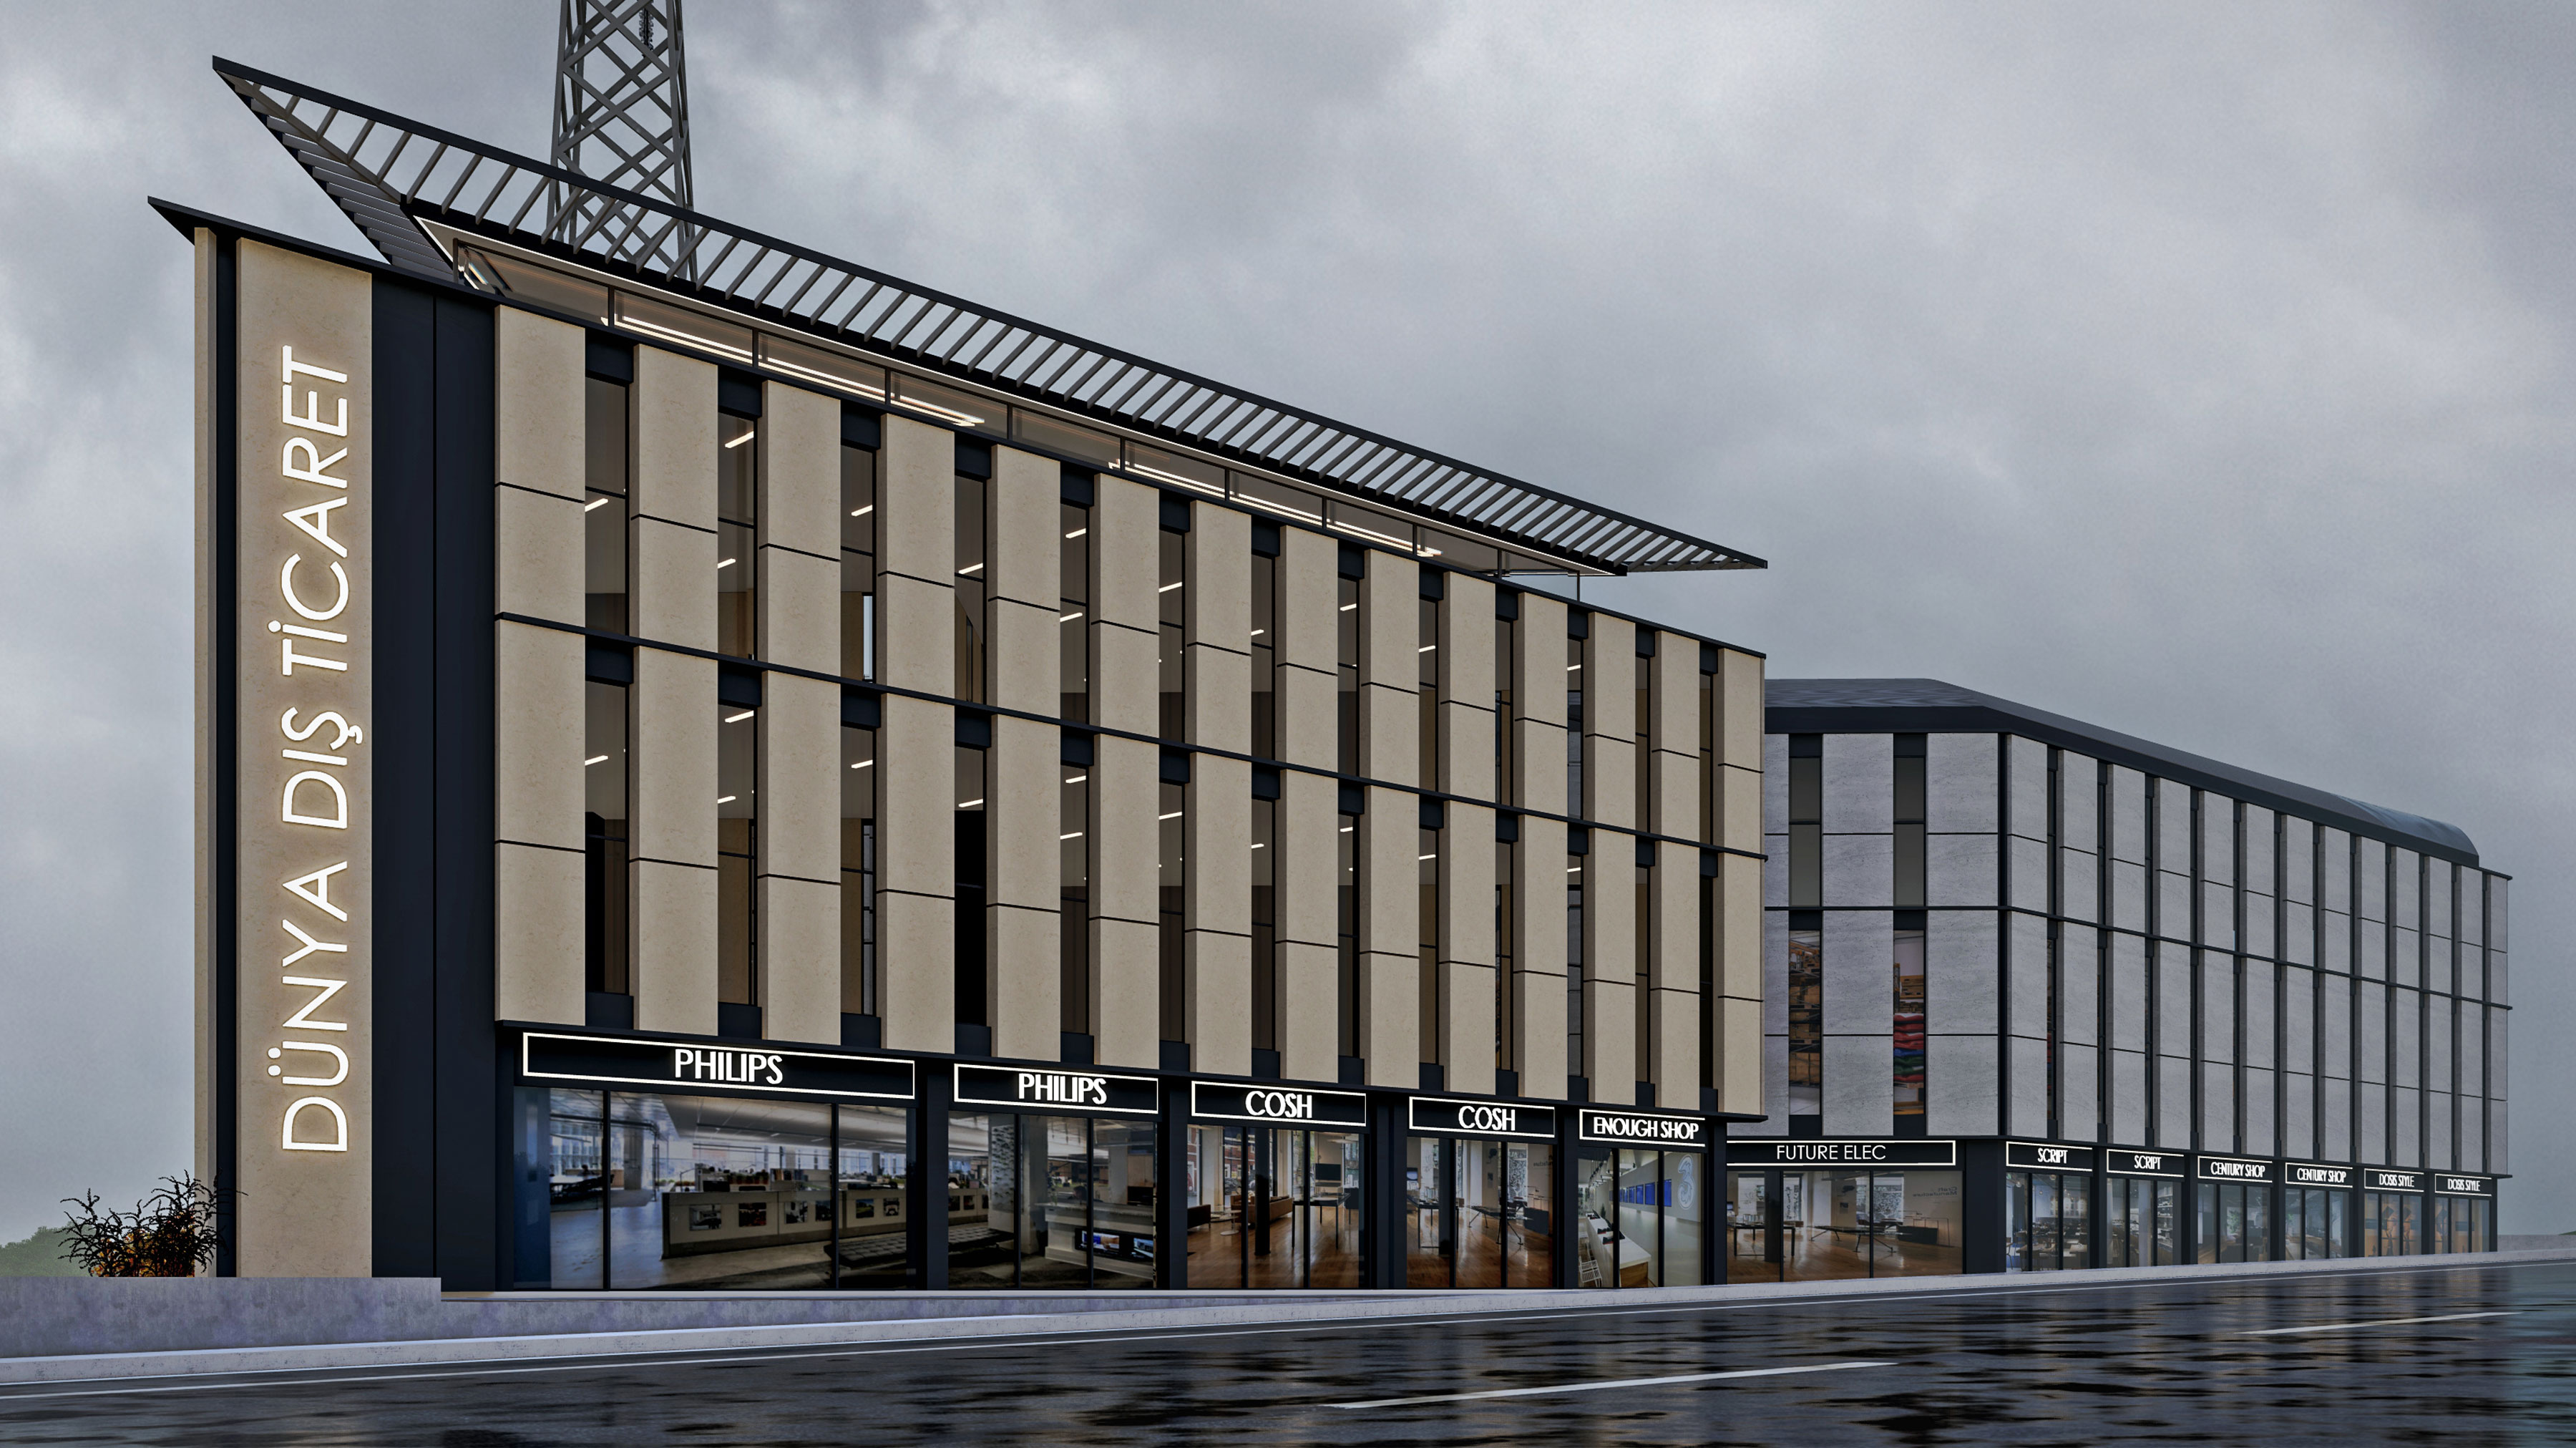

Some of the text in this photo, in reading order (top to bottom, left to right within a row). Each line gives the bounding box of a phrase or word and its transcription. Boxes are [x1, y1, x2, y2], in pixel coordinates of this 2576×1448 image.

[281, 706, 363, 829] DIŞ
[268, 861, 348, 1152] DÜNYA
[675, 1049, 784, 1084] PHILIPS
[1018, 1072, 1107, 1105] PHILIPS
[1245, 1090, 1312, 1119] COSH
[1458, 1105, 1516, 1132] COSH
[1593, 1117, 1699, 1140] ENOUGH SHOP
[1777, 1145, 1886, 1160] FUTURE ELEC
[2037, 1147, 2069, 1165] SCRIPT
[2134, 1155, 2162, 1170] SCRIPT
[2210, 1161, 2265, 1178] CENTURY SHOP
[2296, 1167, 2347, 1183] CENTURY SHOP
[2397, 1175, 2415, 1188] STYLE
[2464, 1179, 2481, 1192] STYLE
